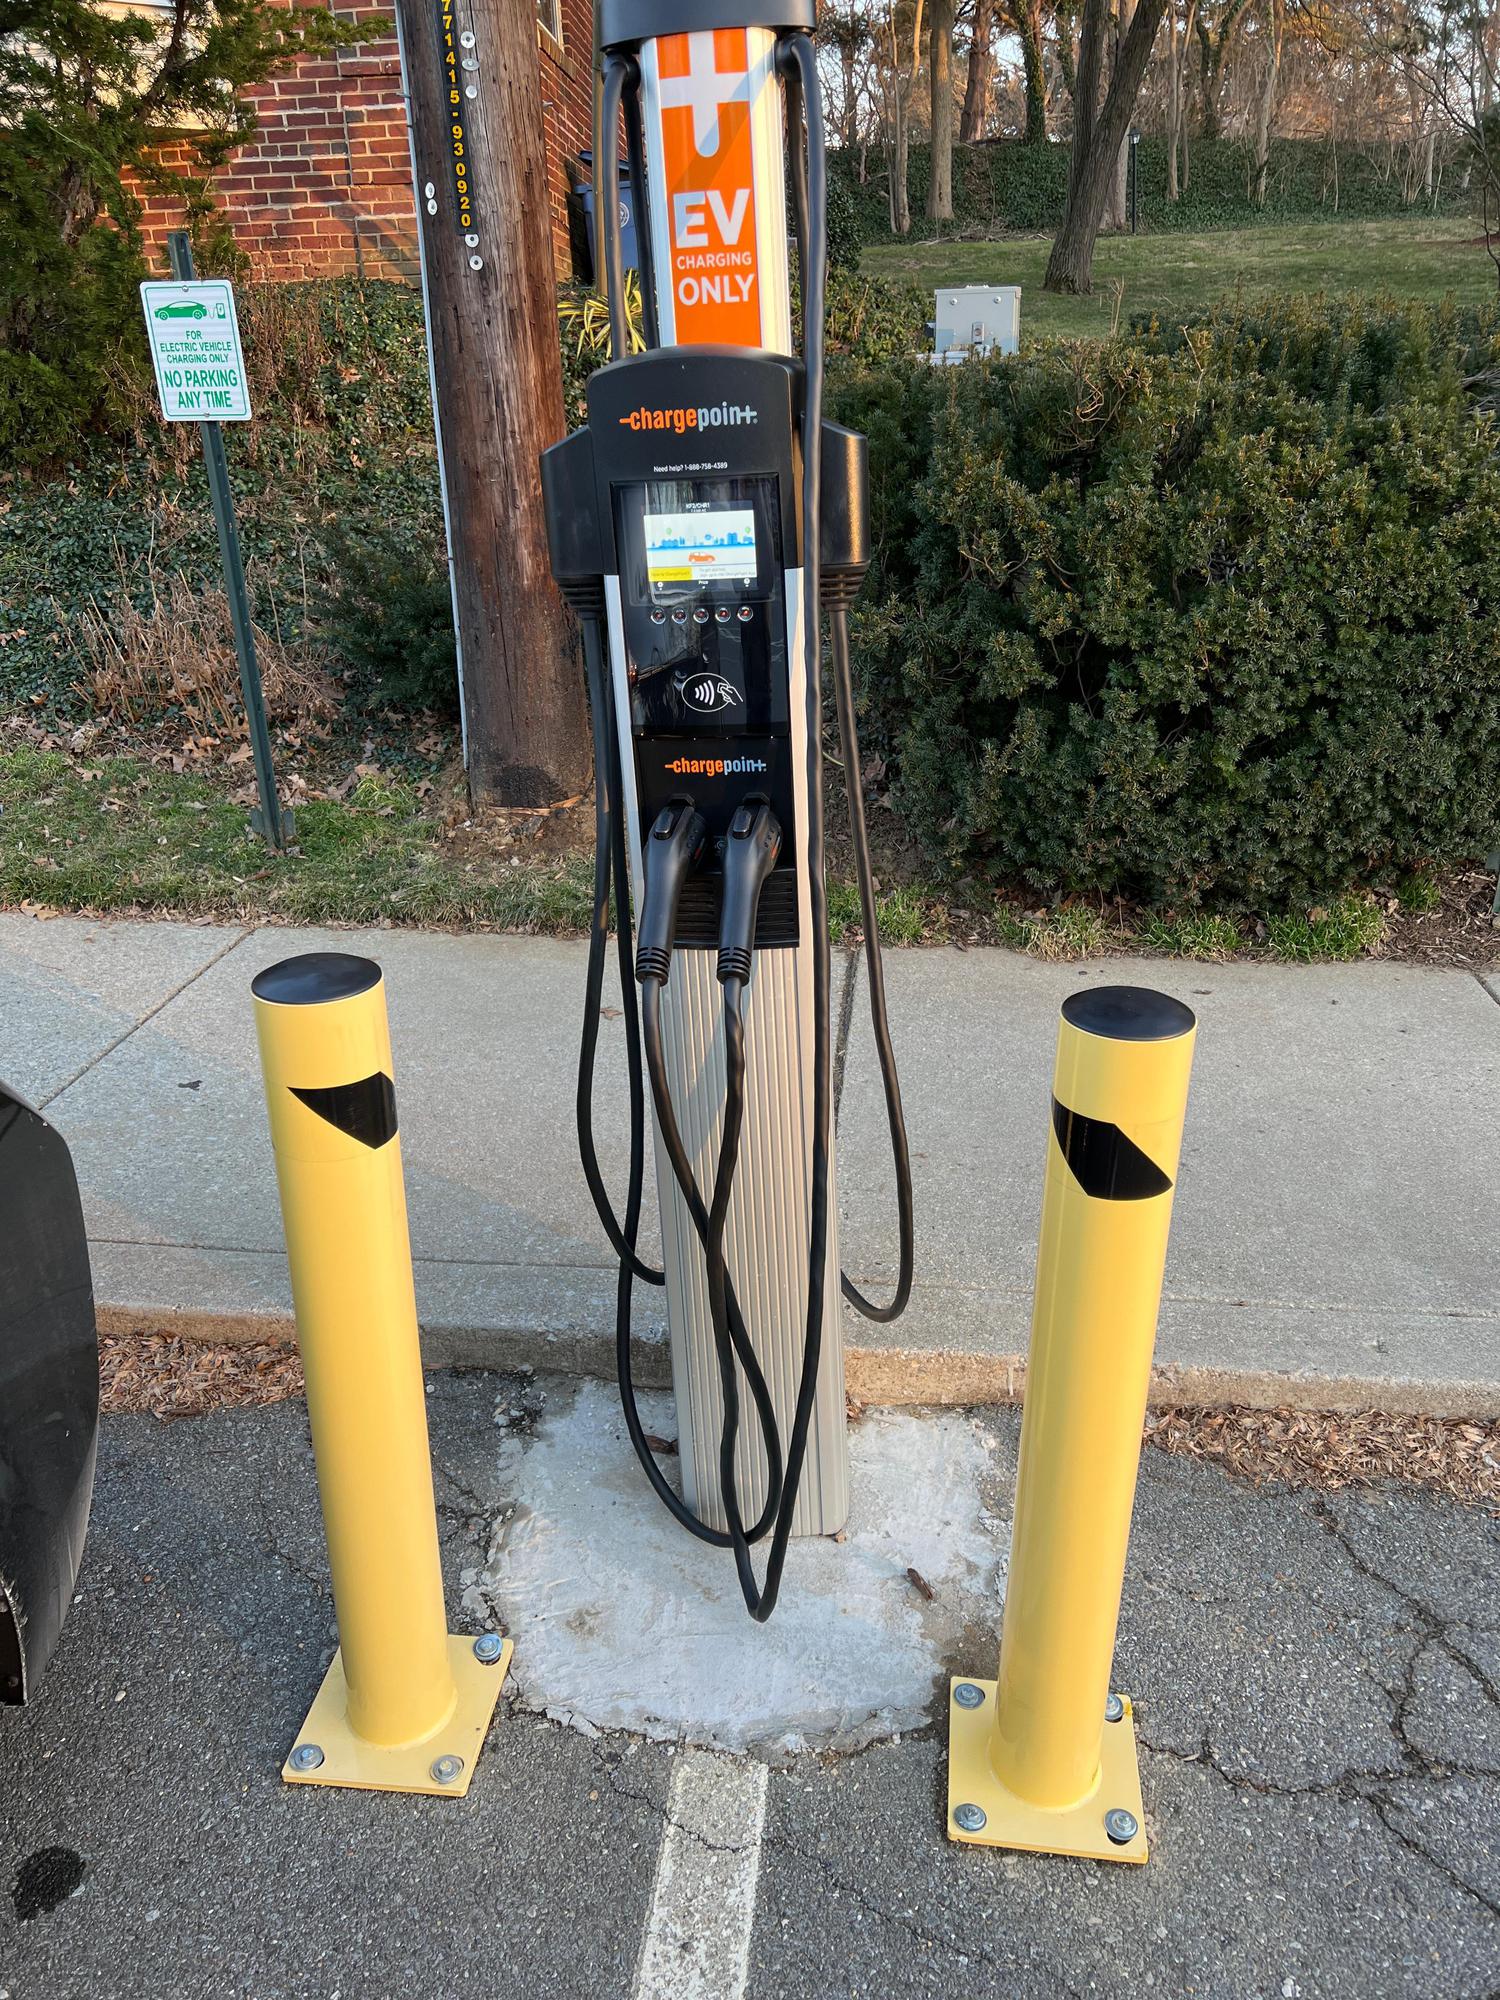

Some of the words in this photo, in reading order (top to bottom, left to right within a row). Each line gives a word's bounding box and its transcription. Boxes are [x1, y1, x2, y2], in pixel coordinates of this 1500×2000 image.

[673, 188, 750, 249] EV
[676, 251, 752, 270] CHARGING
[678, 273, 755, 306] ONLY
[185, 330, 202, 340] FOR
[160, 343, 197, 352] ELECTRIC
[199, 341, 232, 351] VEHICLE
[166, 354, 207, 363] CHARGING
[209, 353, 229, 363] ONLY
[164, 370, 182, 387] NO
[184, 369, 238, 387] PARKING
[178, 391, 200, 408] ANY
[203, 391, 232, 407] TIME
[619, 401, 758, 434] chargepoint
[653, 465, 668, 473] Need
[668, 464, 684, 472] help?
[664, 756, 767, 777] chargepoint
